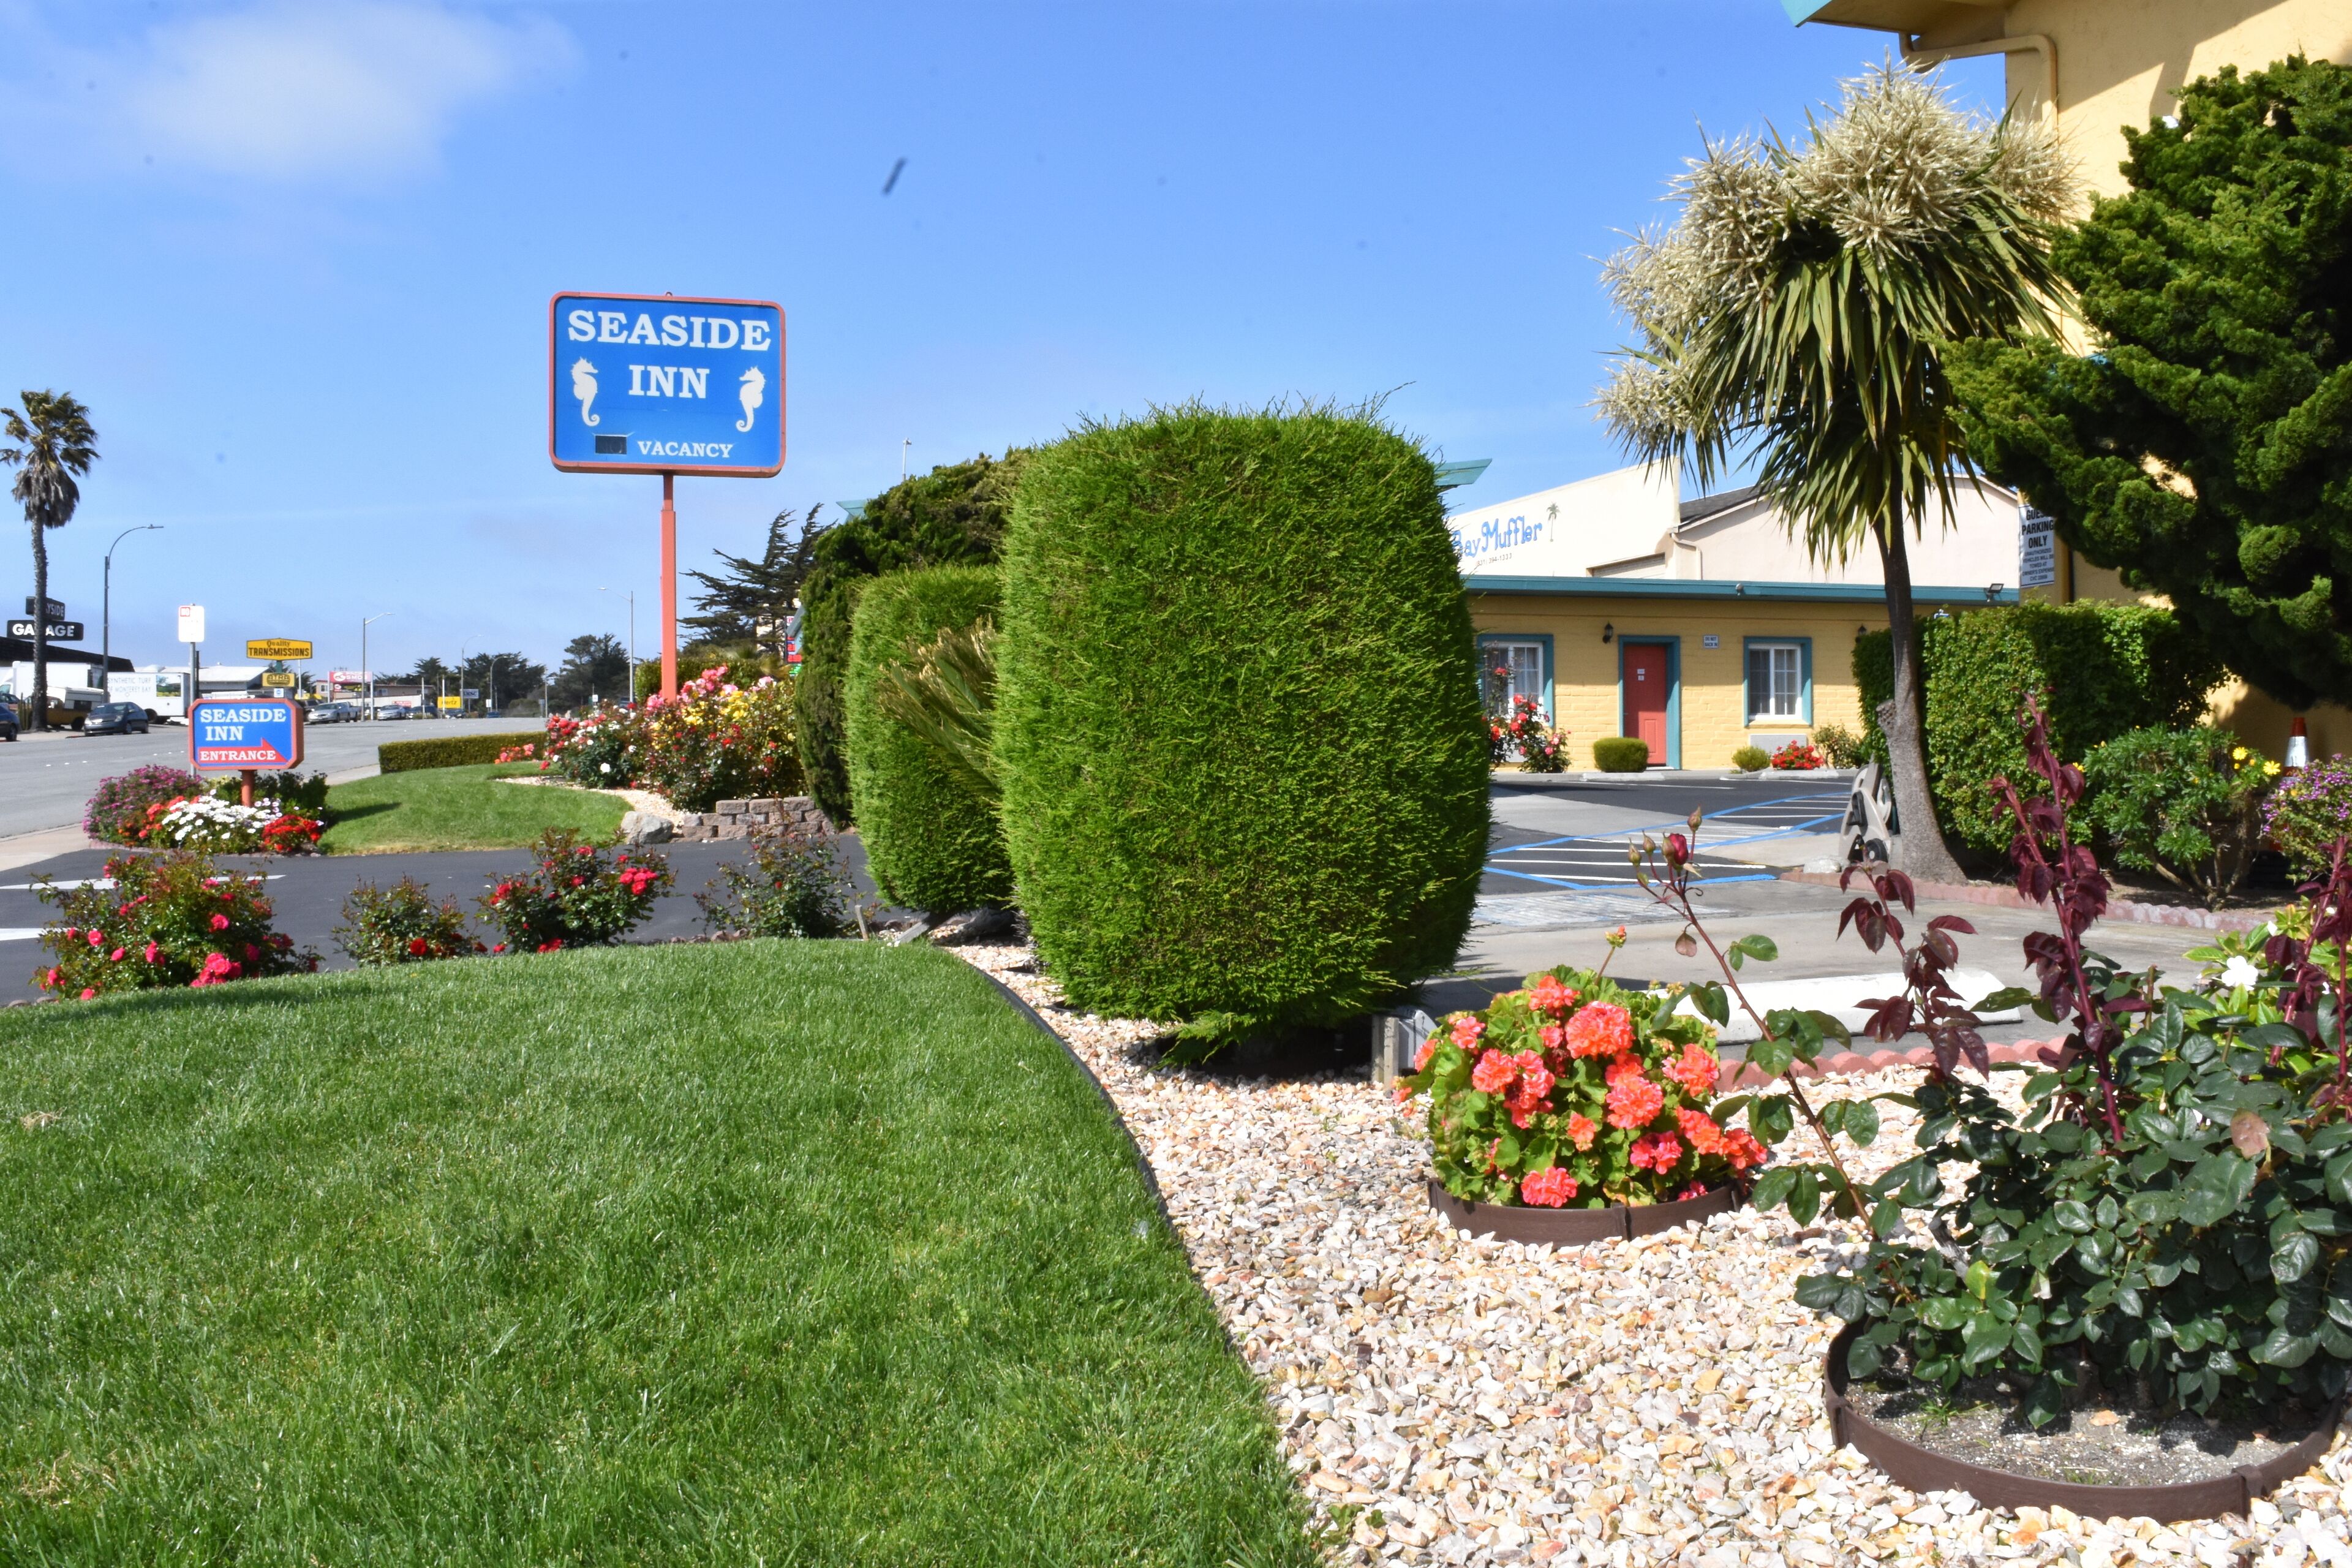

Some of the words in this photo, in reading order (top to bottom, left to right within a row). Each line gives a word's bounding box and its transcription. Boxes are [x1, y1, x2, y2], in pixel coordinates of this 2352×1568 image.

[568, 310, 771, 351] SEASIDE
[628, 364, 710, 399] INN
[637, 441, 733, 458] VACANCY
[2026, 509, 2046, 521] GUE
[2021, 520, 2054, 535] PARKING
[1452, 530, 1480, 557] Bay
[1482, 515, 1542, 552] Muffler
[2029, 535, 2048, 548] ONLY
[12, 623, 75, 637] GAAGE
[248, 647, 309, 657] TRANSMISSIONS
[200, 709, 287, 723] SEASIDE
[205, 726, 244, 741] INN
[200, 750, 276, 761] ENTRANCE
